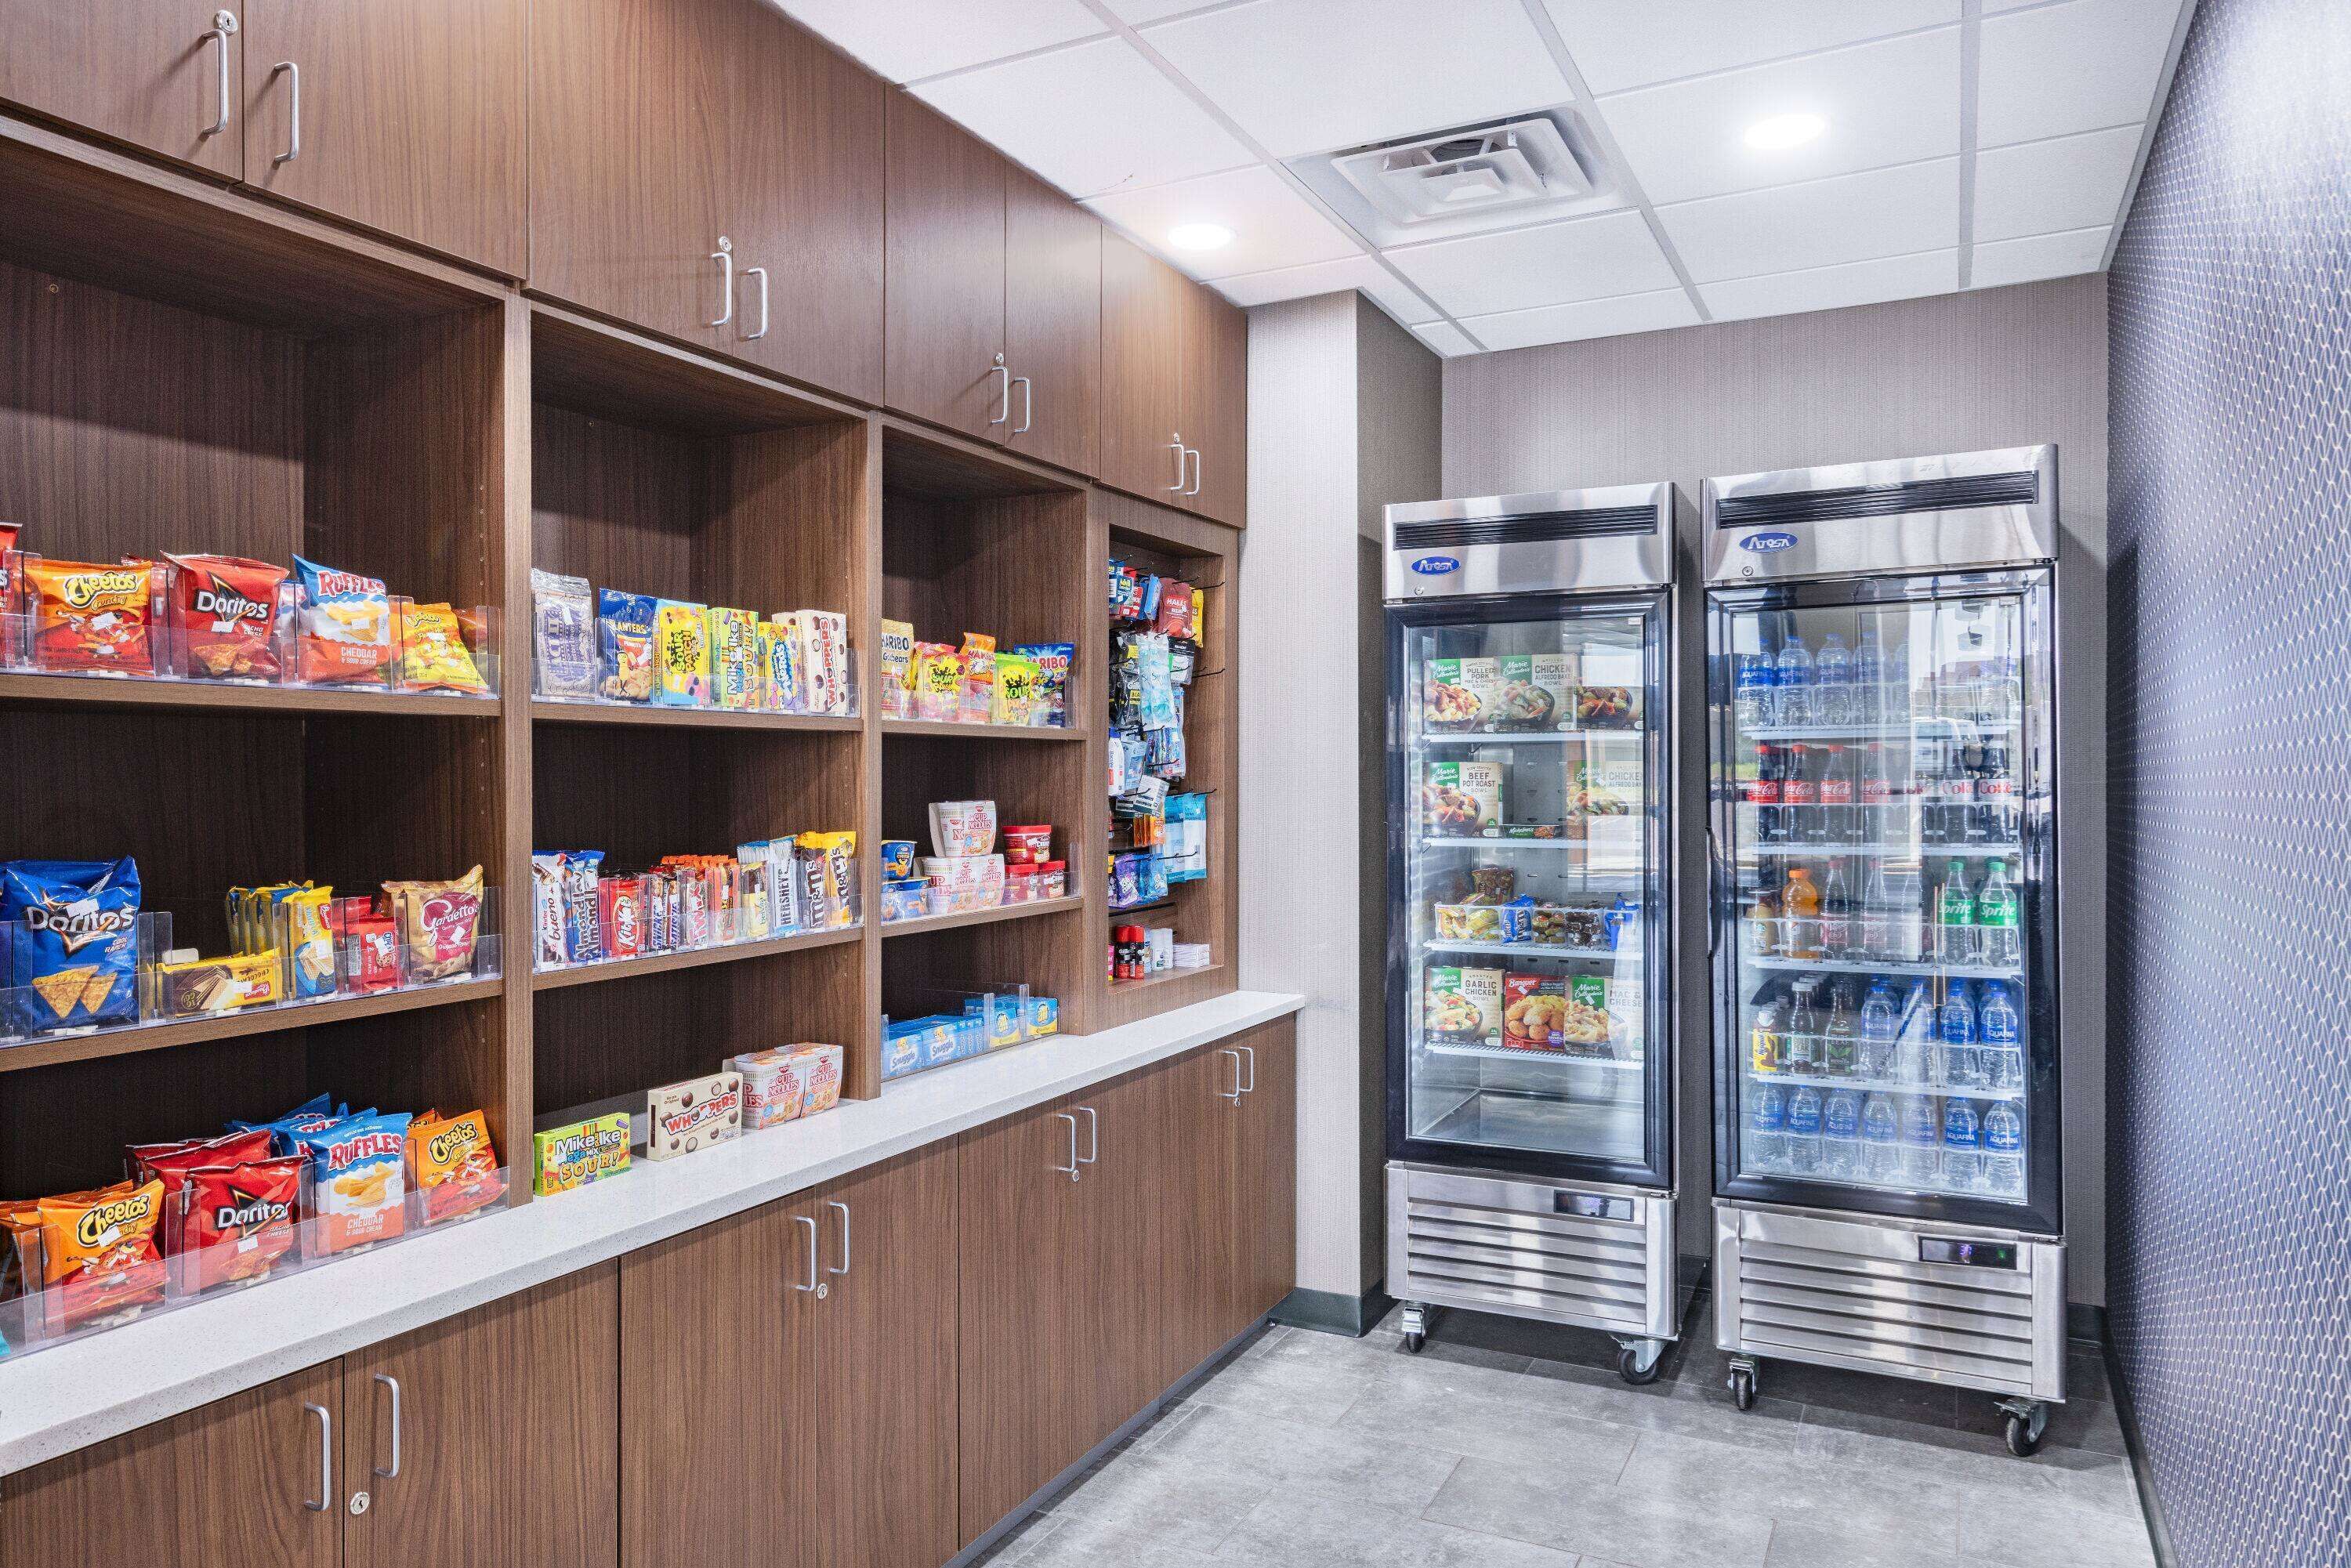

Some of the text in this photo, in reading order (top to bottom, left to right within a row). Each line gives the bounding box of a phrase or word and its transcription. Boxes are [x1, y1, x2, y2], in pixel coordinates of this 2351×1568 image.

[66, 573, 138, 604] Cheetos
[318, 570, 386, 597] RUFFLES
[197, 591, 269, 619] Doritos
[341, 647, 378, 658] CHEDDAR
[673, 631, 685, 672] SOUR
[683, 629, 695, 672] PATCH
[1534, 665, 1571, 674] CHICKEN
[777, 868, 792, 925] HERSHEY'S
[1939, 902, 1972, 914] Sprite
[27, 905, 136, 934] Doritos
[548, 897, 561, 942] bueno
[1980, 904, 2016, 918] Sprite
[1465, 980, 1498, 990] GARLIC
[1465, 988, 1498, 997] CHICKEN
[892, 1050, 916, 1066] Snuggle
[932, 1039, 954, 1057] Snuggle
[328, 1134, 403, 1171] RUFFLES
[429, 1123, 477, 1164] Cheetos
[555, 1135, 596, 1155] Mike
[599, 1129, 621, 1145] Ike
[1990, 1135, 2019, 1144] AQUAFINA
[78, 1194, 150, 1246] Cheetos
[347, 1214, 384, 1229] CHEDDAR
